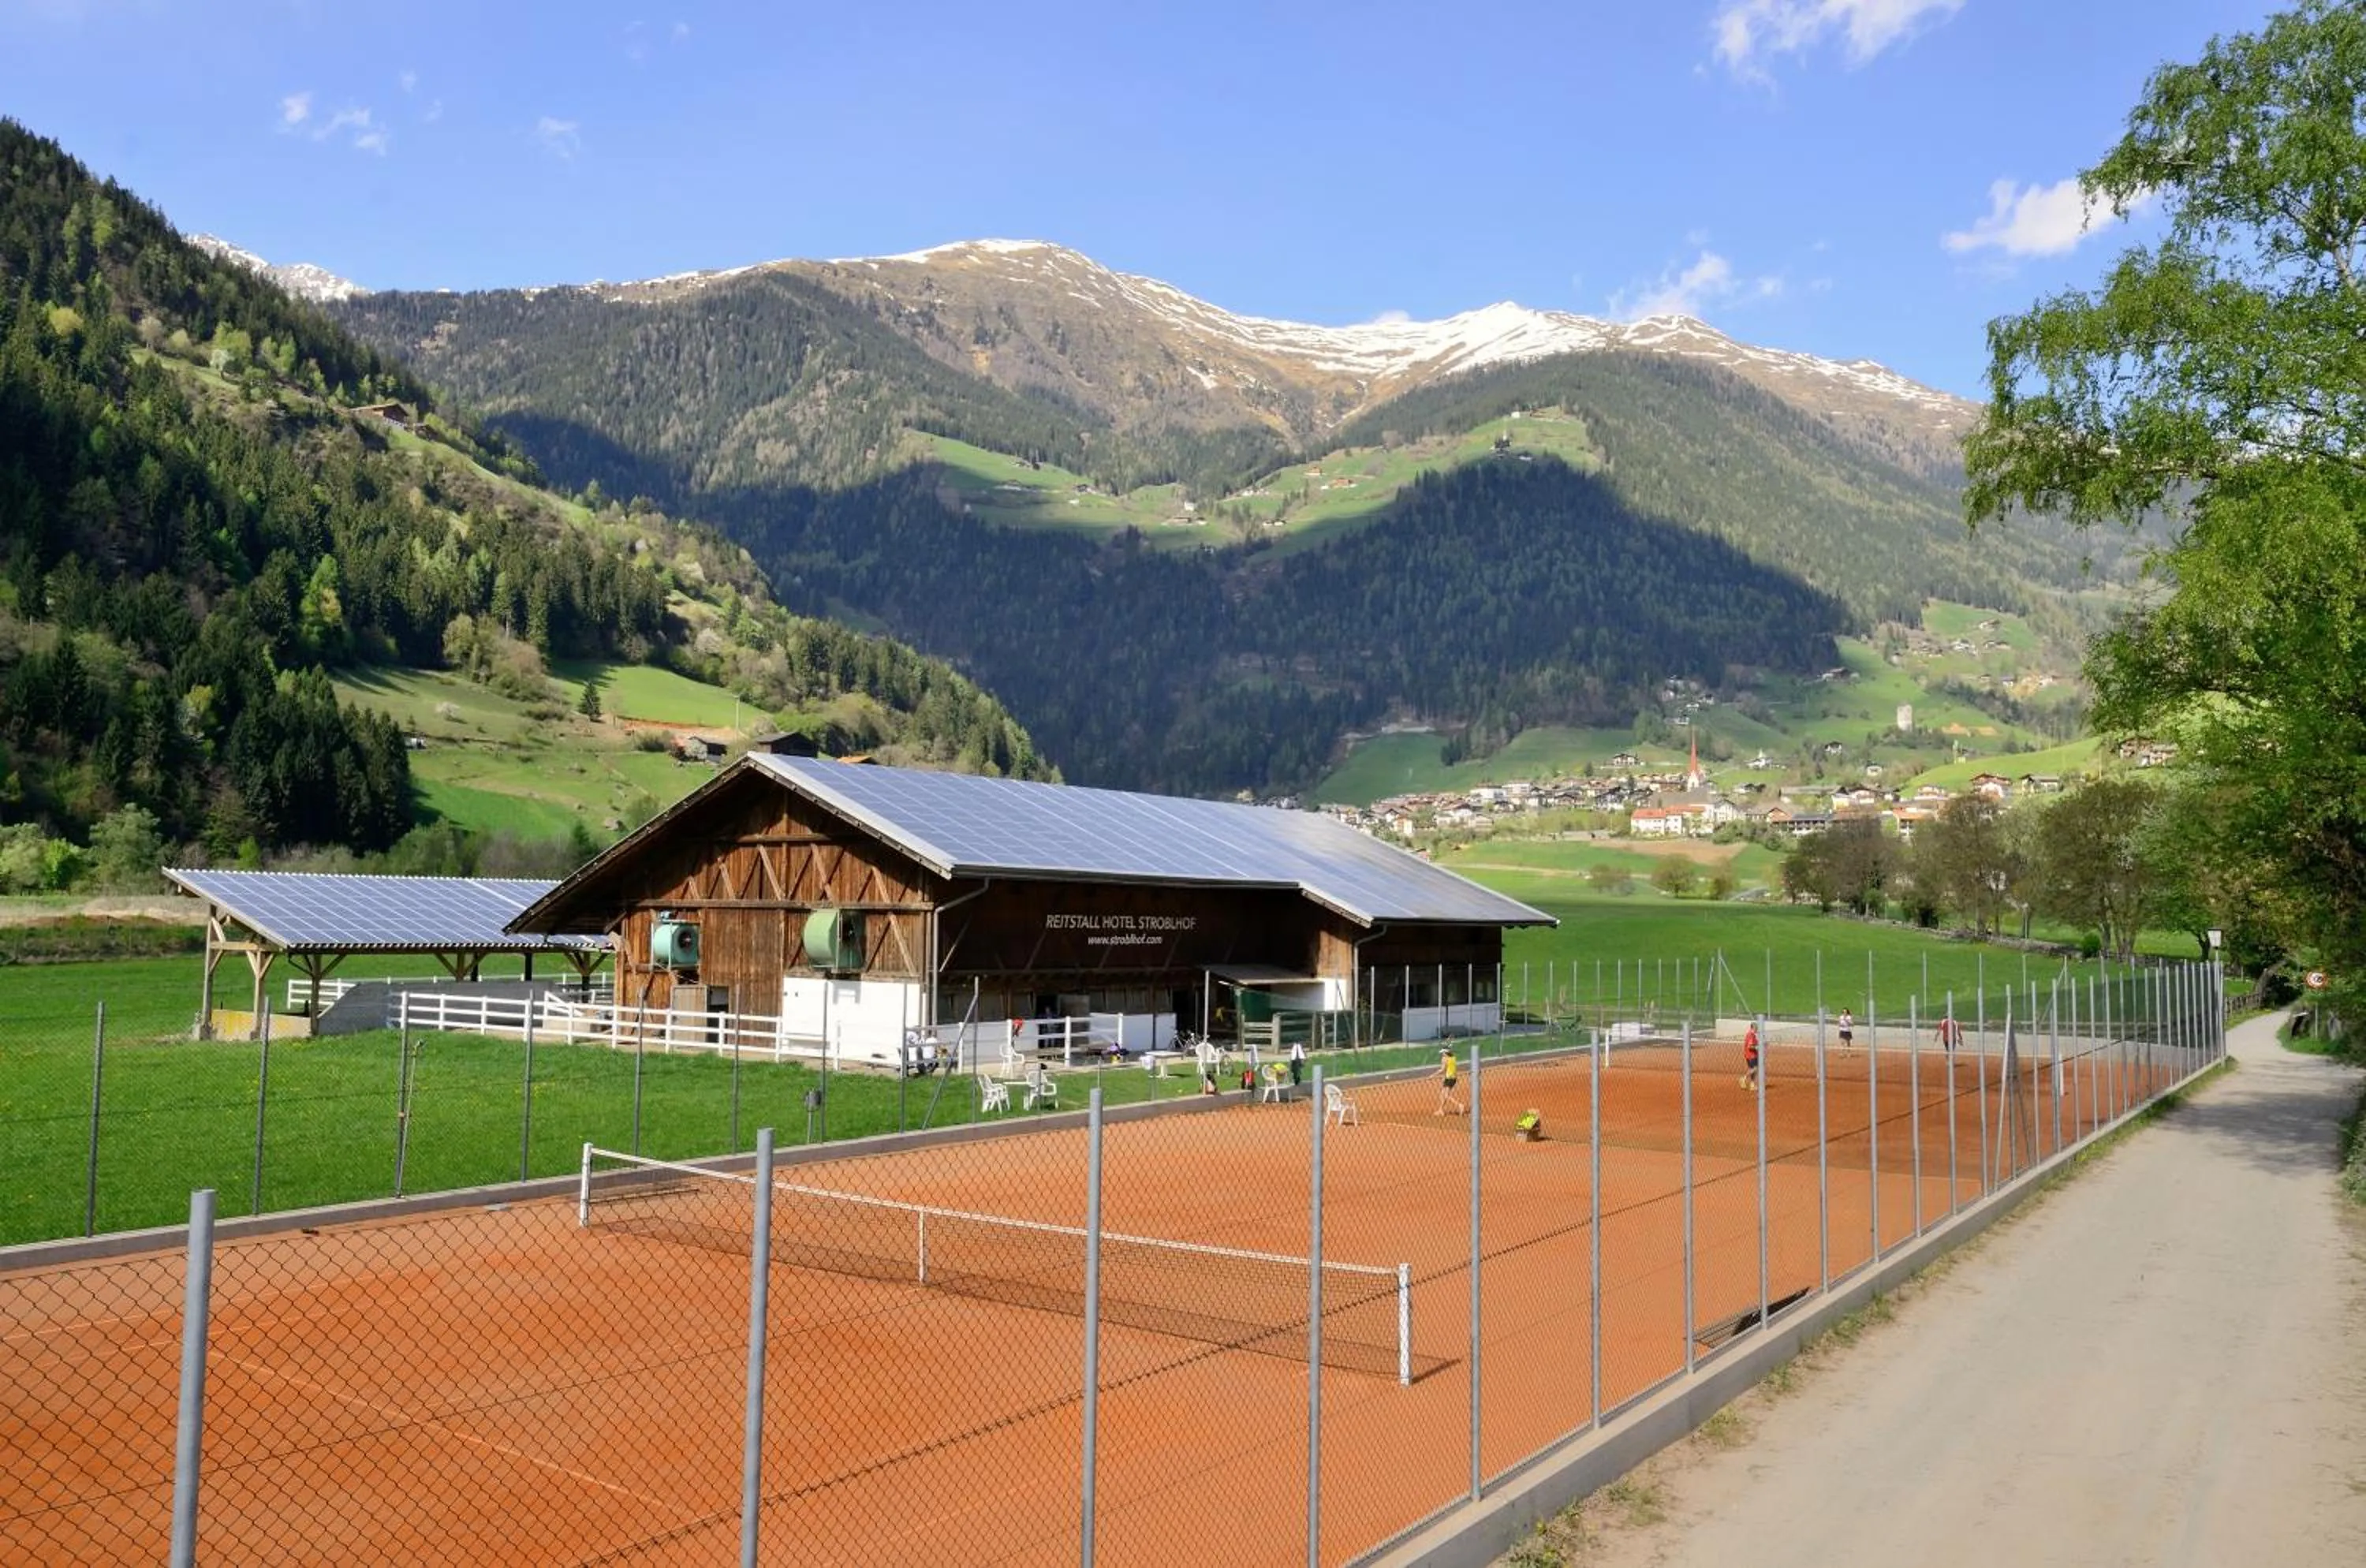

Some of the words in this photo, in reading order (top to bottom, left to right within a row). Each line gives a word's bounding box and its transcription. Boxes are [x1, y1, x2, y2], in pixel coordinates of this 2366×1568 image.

[1046, 914, 1100, 929] REITSTALL
[1102, 916, 1136, 929] HOTEL
[1138, 917, 1197, 930] STROBLHOF
[1088, 934, 1162, 945] www.stroblhof.com
